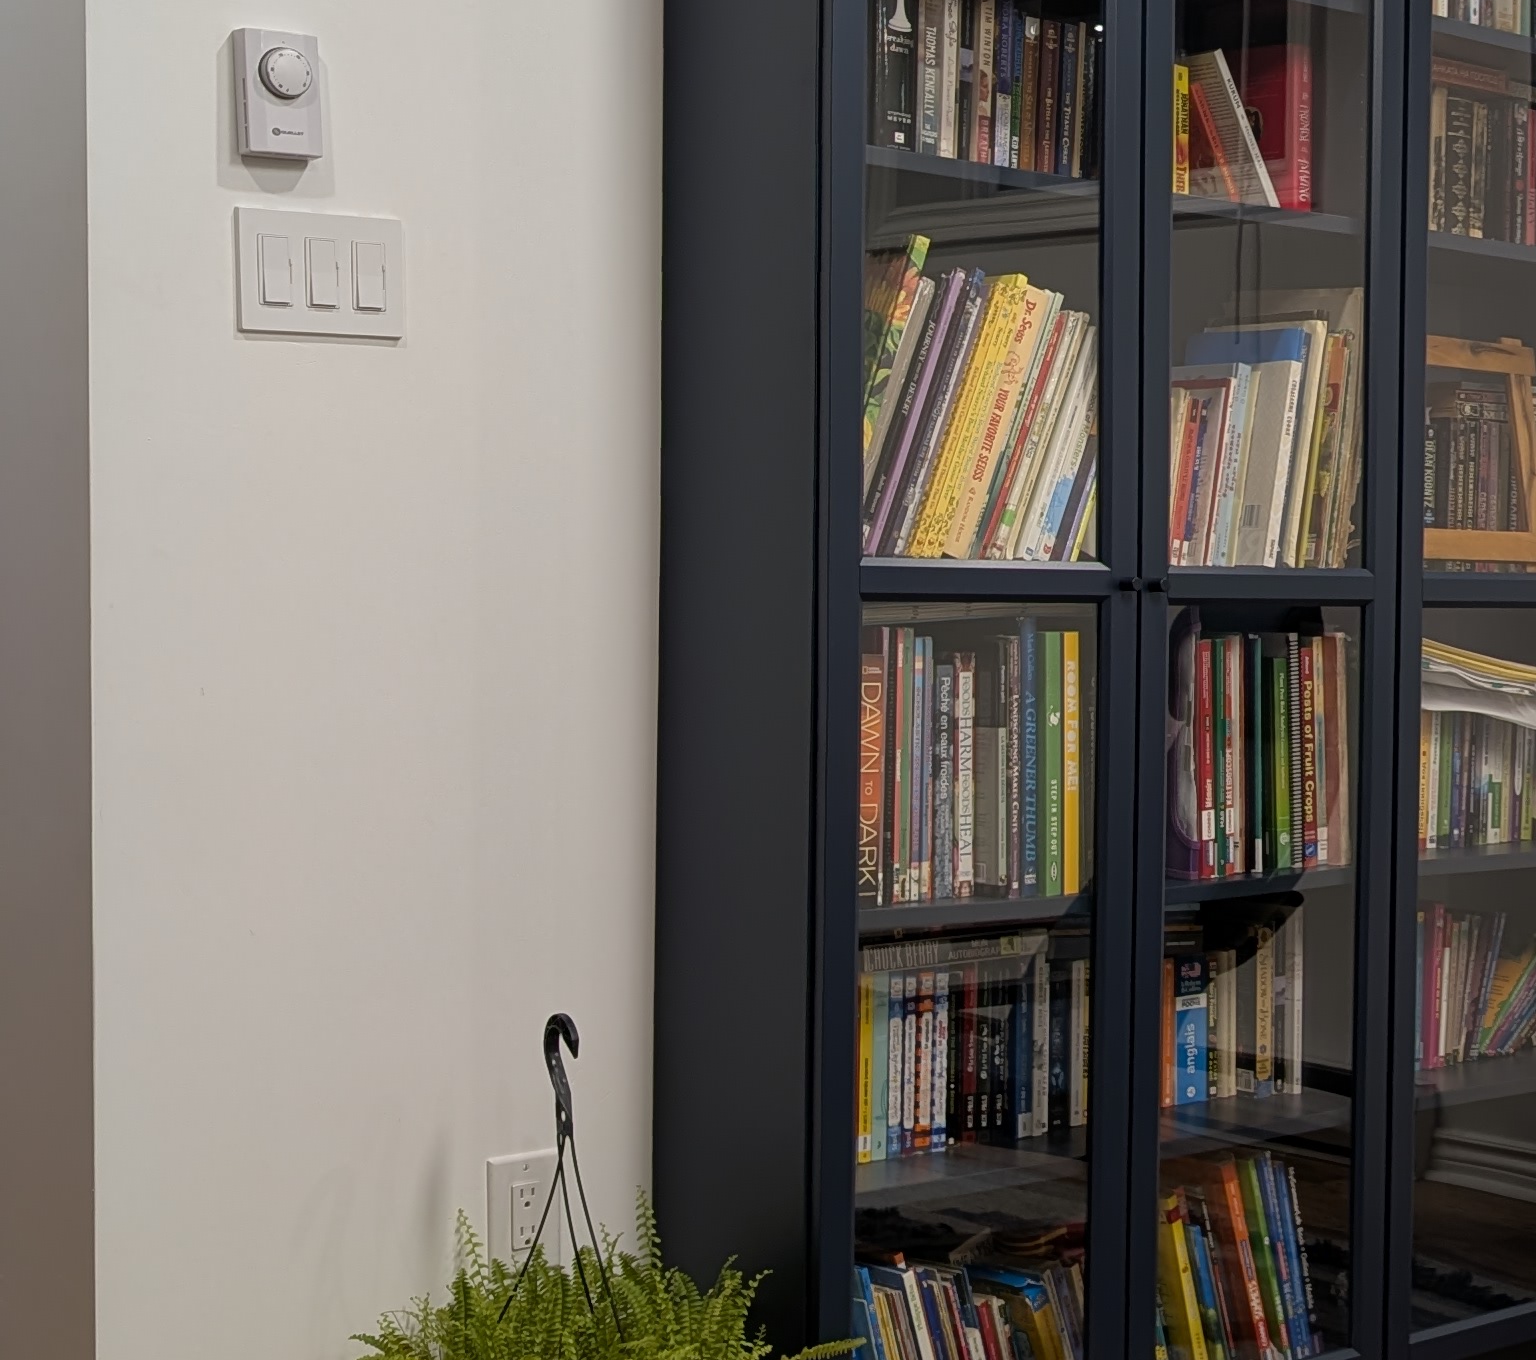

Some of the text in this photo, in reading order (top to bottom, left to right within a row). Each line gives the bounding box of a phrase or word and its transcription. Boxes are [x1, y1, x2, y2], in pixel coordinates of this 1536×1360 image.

[1001, 0, 1010, 30] NORA
[890, 43, 909, 55] dawn
[982, 28, 992, 66] WINTON
[1000, 33, 1009, 77] ROBERTS
[923, 25, 937, 117] THOMAS KENEALLY
[1180, 92, 1189, 135] JONATHAN
[980, 119, 989, 158] BREATH
[1011, 136, 1019, 149] KID
[1021, 298, 1036, 317] Dr.
[916, 319, 936, 362] JOURNEY
[1012, 315, 1032, 345] Seuss
[900, 381, 917, 416] DESERT
[992, 386, 1009, 412] YOUR
[980, 411, 1002, 453] FAVORITE
[1069, 422, 1090, 468] Monsters
[875, 473, 887, 491] John
[971, 451, 989, 482] SEUSS
[1421, 439, 1435, 507] DEAN KOONTZ
[960, 676, 971, 716] FOODS
[1025, 690, 1036, 705] A
[1303, 680, 1313, 721] Pests
[939, 715, 949, 730] en
[1066, 660, 1078, 791] ROOM FOR ME!
[1278, 714, 1286, 737] Analysis
[1303, 725, 1313, 739] of
[939, 732, 949, 759] eaux
[959, 717, 972, 772] HARM
[1011, 694, 1020, 834] LANDSCAPING MAKES CENTS
[1025, 707, 1035, 791] GREENER
[1304, 743, 1314, 777] Fruit
[858, 682, 882, 886] DAWN TO DARK
[939, 761, 951, 800] froides
[1050, 779, 1058, 801] STEP
[1302, 780, 1314, 823] Crops
[959, 813, 972, 863] HEAL
[1024, 796, 1037, 862] THUMB
[1050, 816, 1058, 838] STEP
[1050, 839, 1058, 856] OUT
[868, 942, 939, 972] CHUCK BERRY
[1257, 953, 1269, 1041] SHADOW BONE
[1183, 1022, 1198, 1073] anglais
